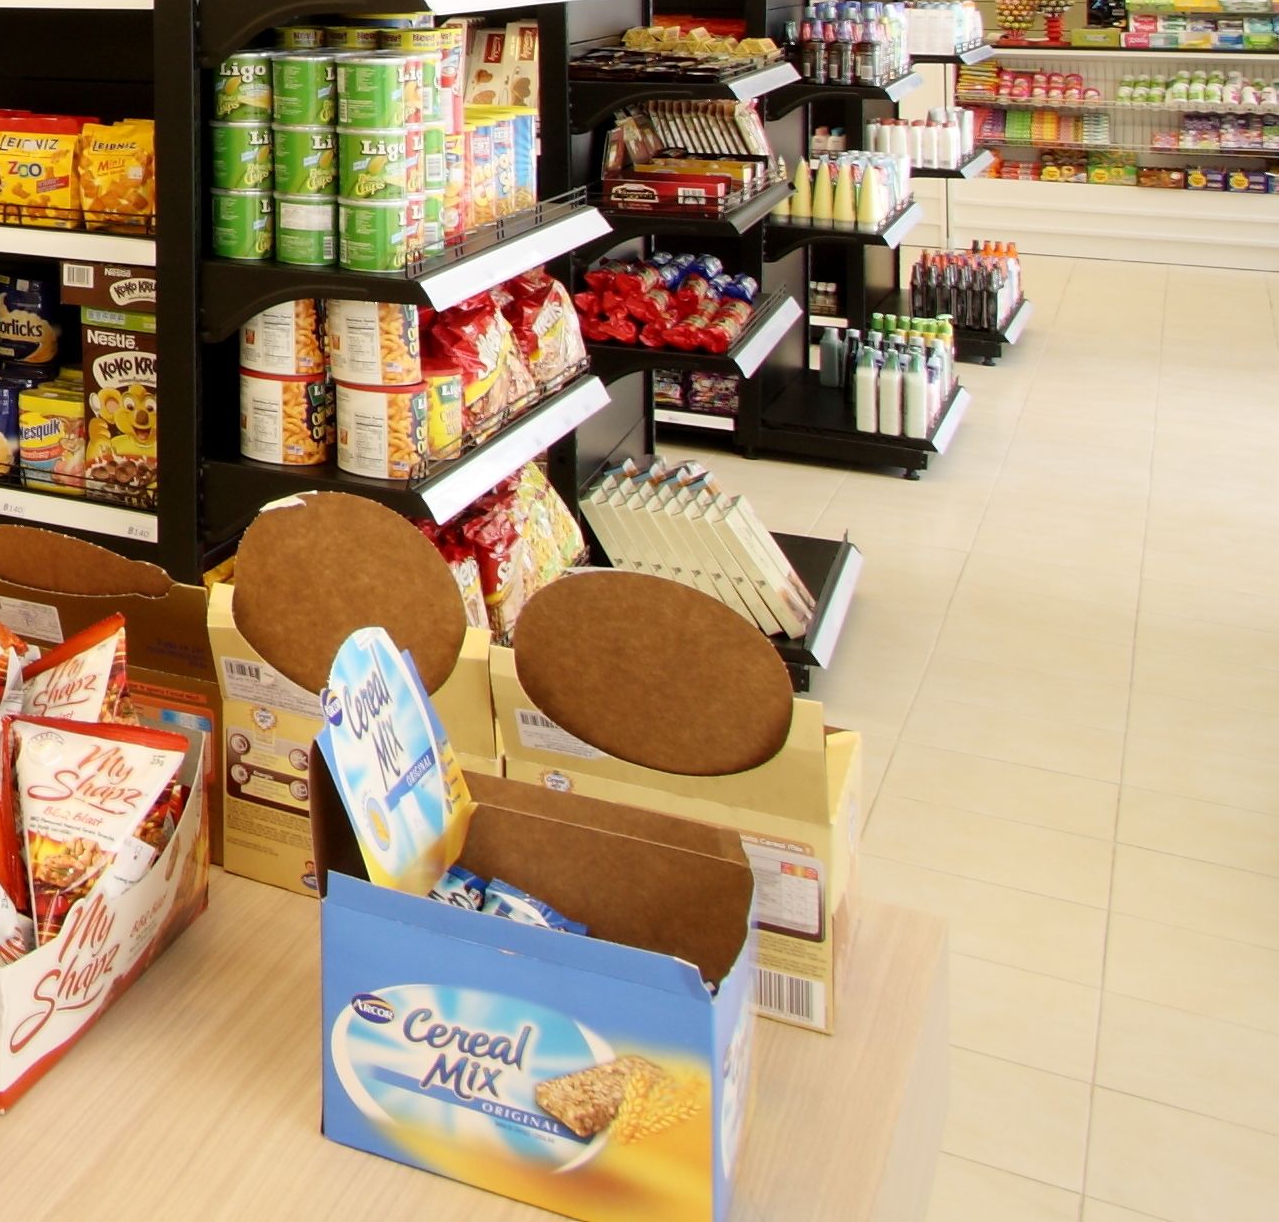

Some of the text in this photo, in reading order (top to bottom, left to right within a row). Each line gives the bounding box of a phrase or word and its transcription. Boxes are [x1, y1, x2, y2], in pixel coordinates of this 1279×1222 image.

[219, 62, 266, 83] Ligo
[343, 642, 394, 740] Cereal
[77, 744, 134, 786] My
[27, 769, 142, 811] Shapz
[58, 892, 116, 963] My
[9, 943, 120, 1053] Shapz
[402, 1007, 532, 1070] Cereal
[419, 1052, 503, 1101] Mix
[481, 1100, 561, 1134] ORIGINAL
